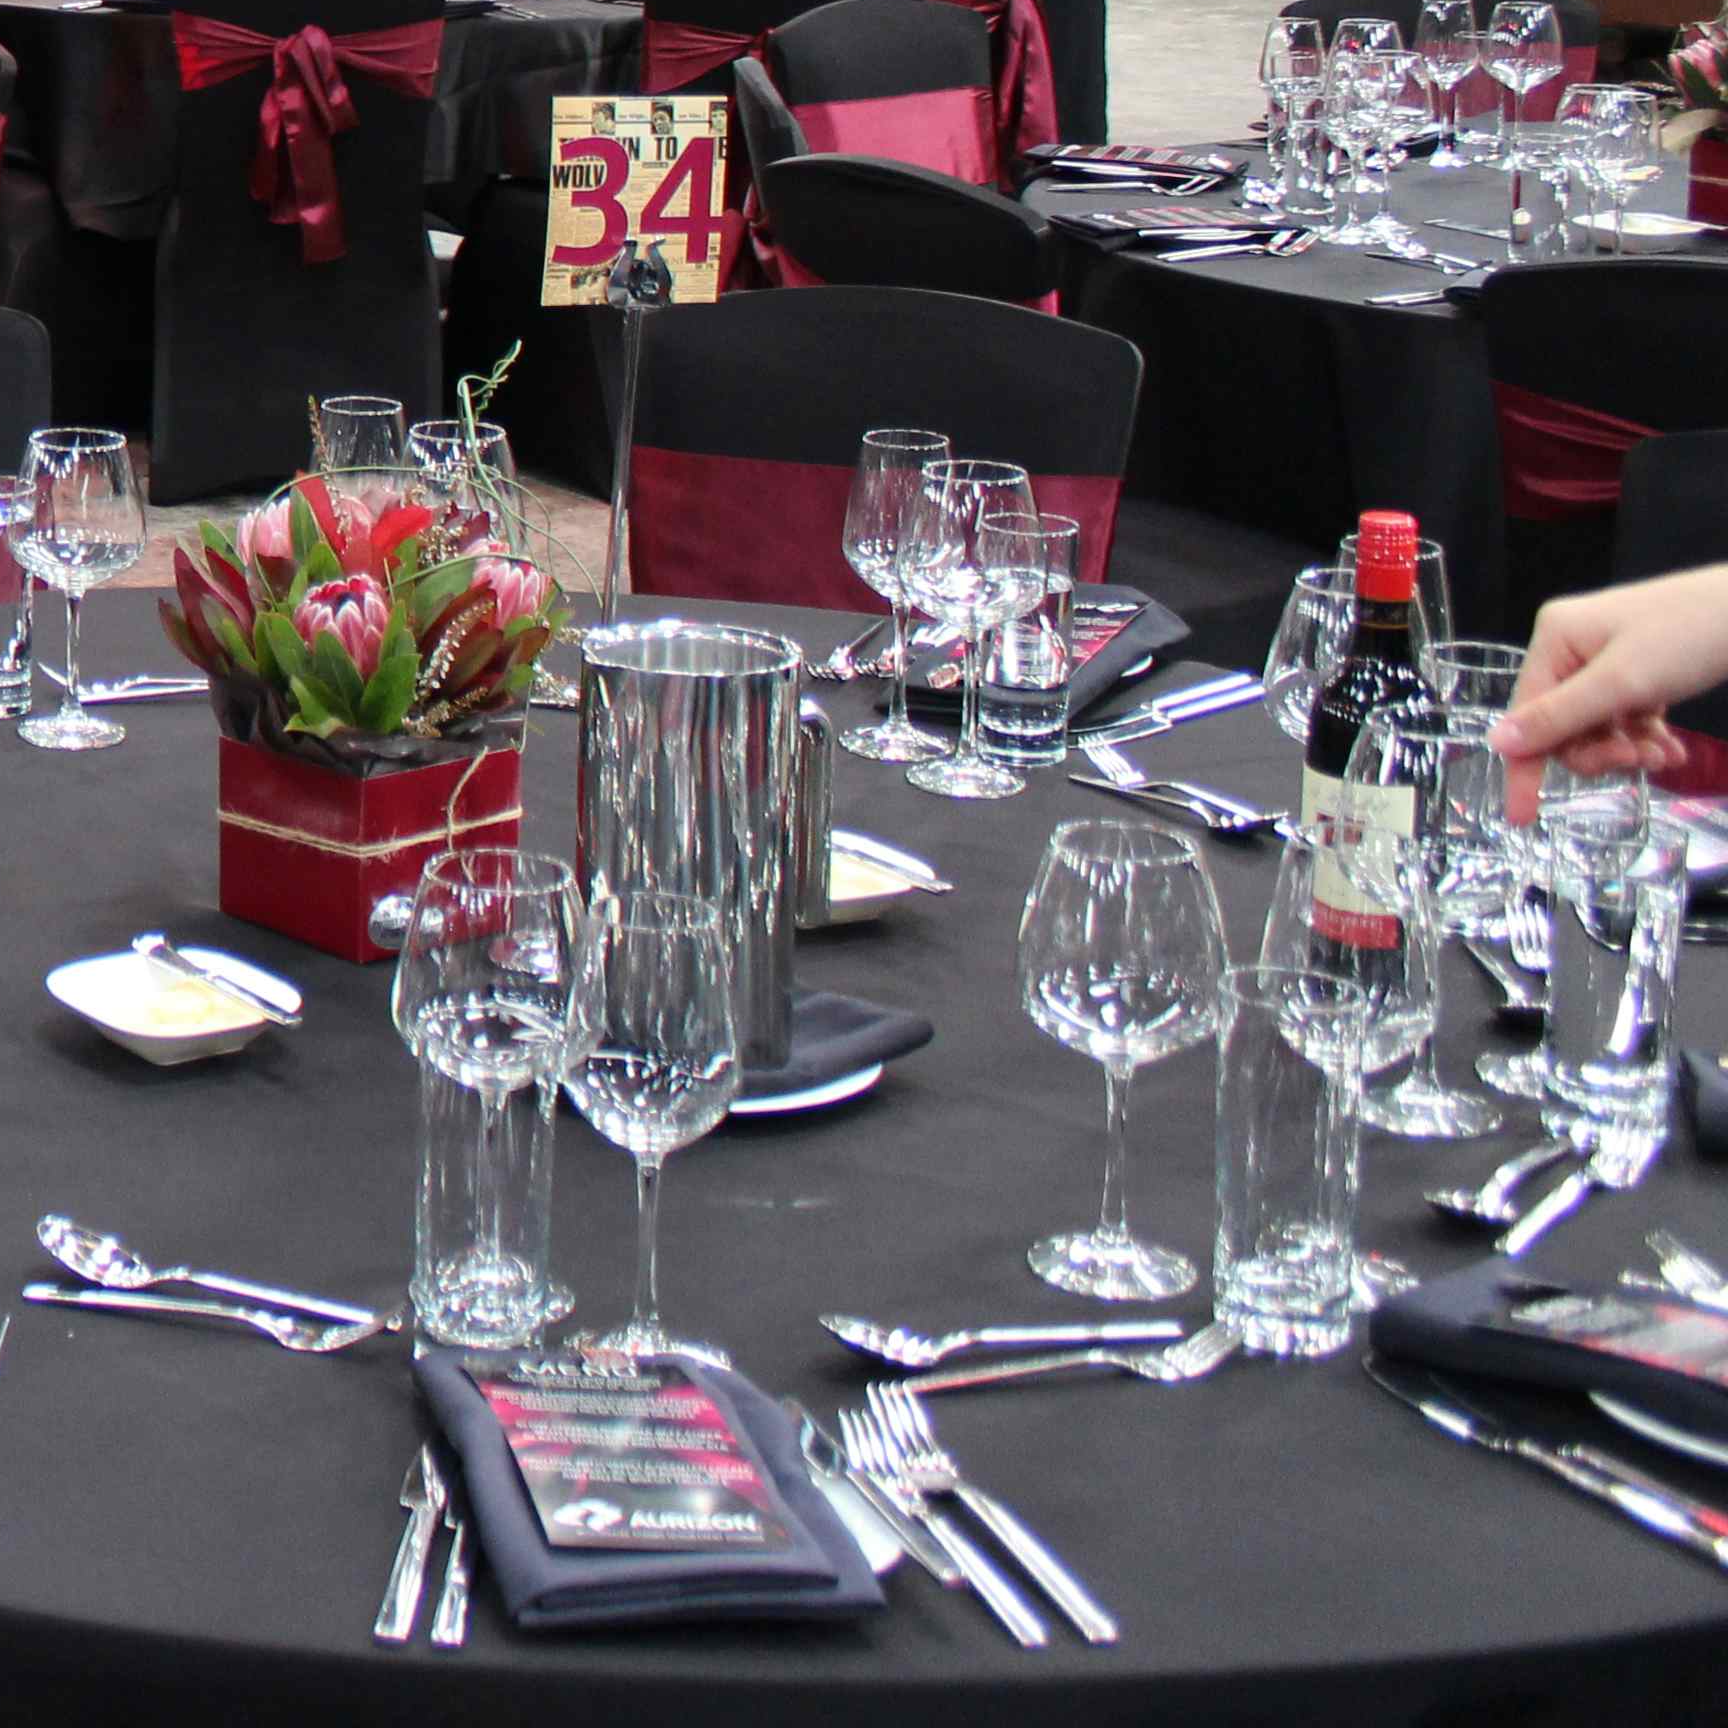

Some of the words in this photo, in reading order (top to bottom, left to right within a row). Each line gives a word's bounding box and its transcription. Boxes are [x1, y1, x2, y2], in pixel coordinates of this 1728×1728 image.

[656, 137, 677, 160] TO
[552, 137, 723, 266] 34
[629, 1510, 757, 1533] AURIZON
